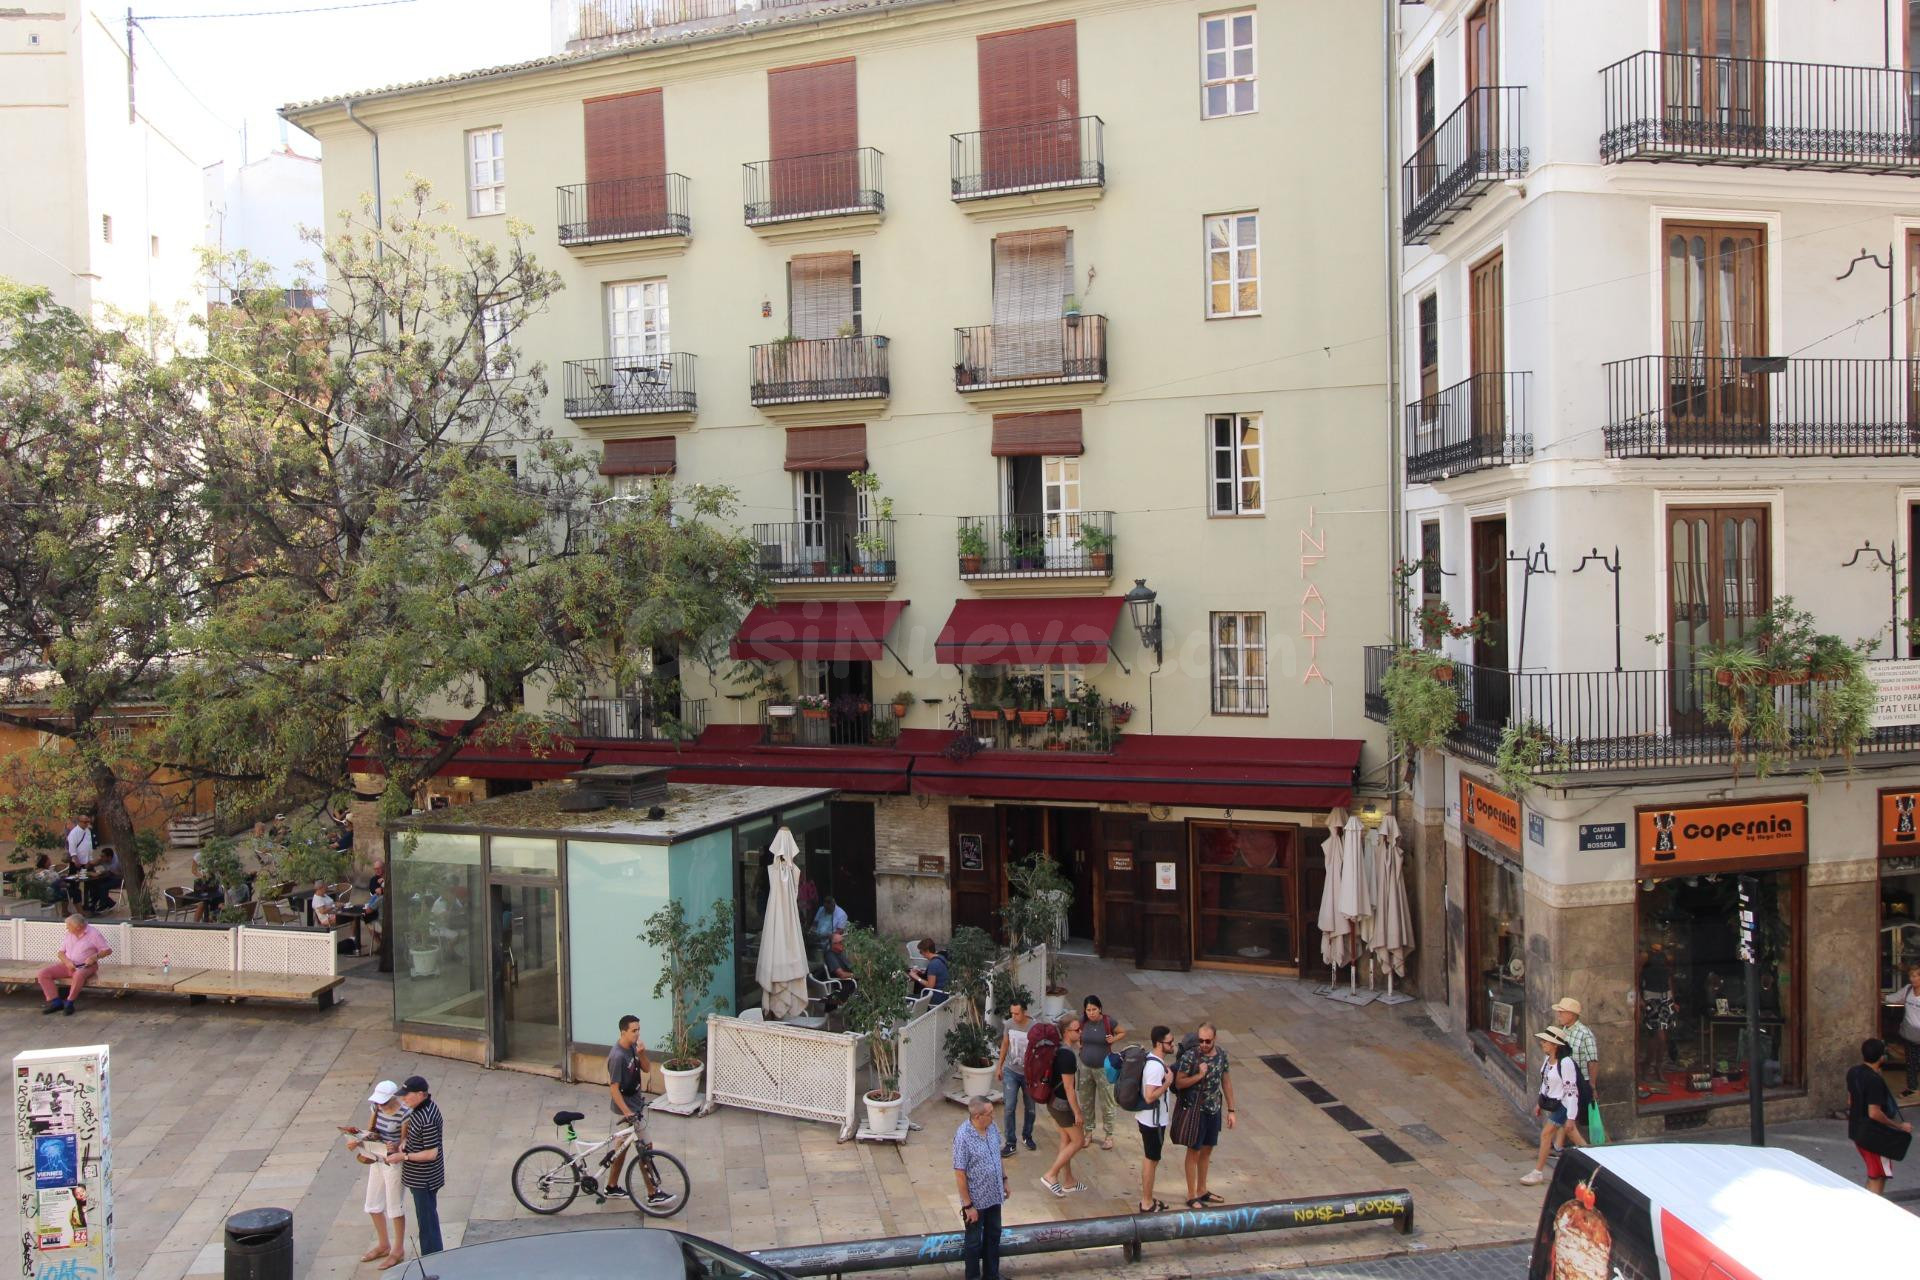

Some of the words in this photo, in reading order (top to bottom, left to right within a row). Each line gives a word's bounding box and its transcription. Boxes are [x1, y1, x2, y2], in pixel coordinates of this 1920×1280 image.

[1299, 505, 1327, 685] INFANTA
[1476, 797, 1517, 830] Copernia
[1683, 814, 1792, 842] Copernia
[74, 1231, 87, 1241] 26
